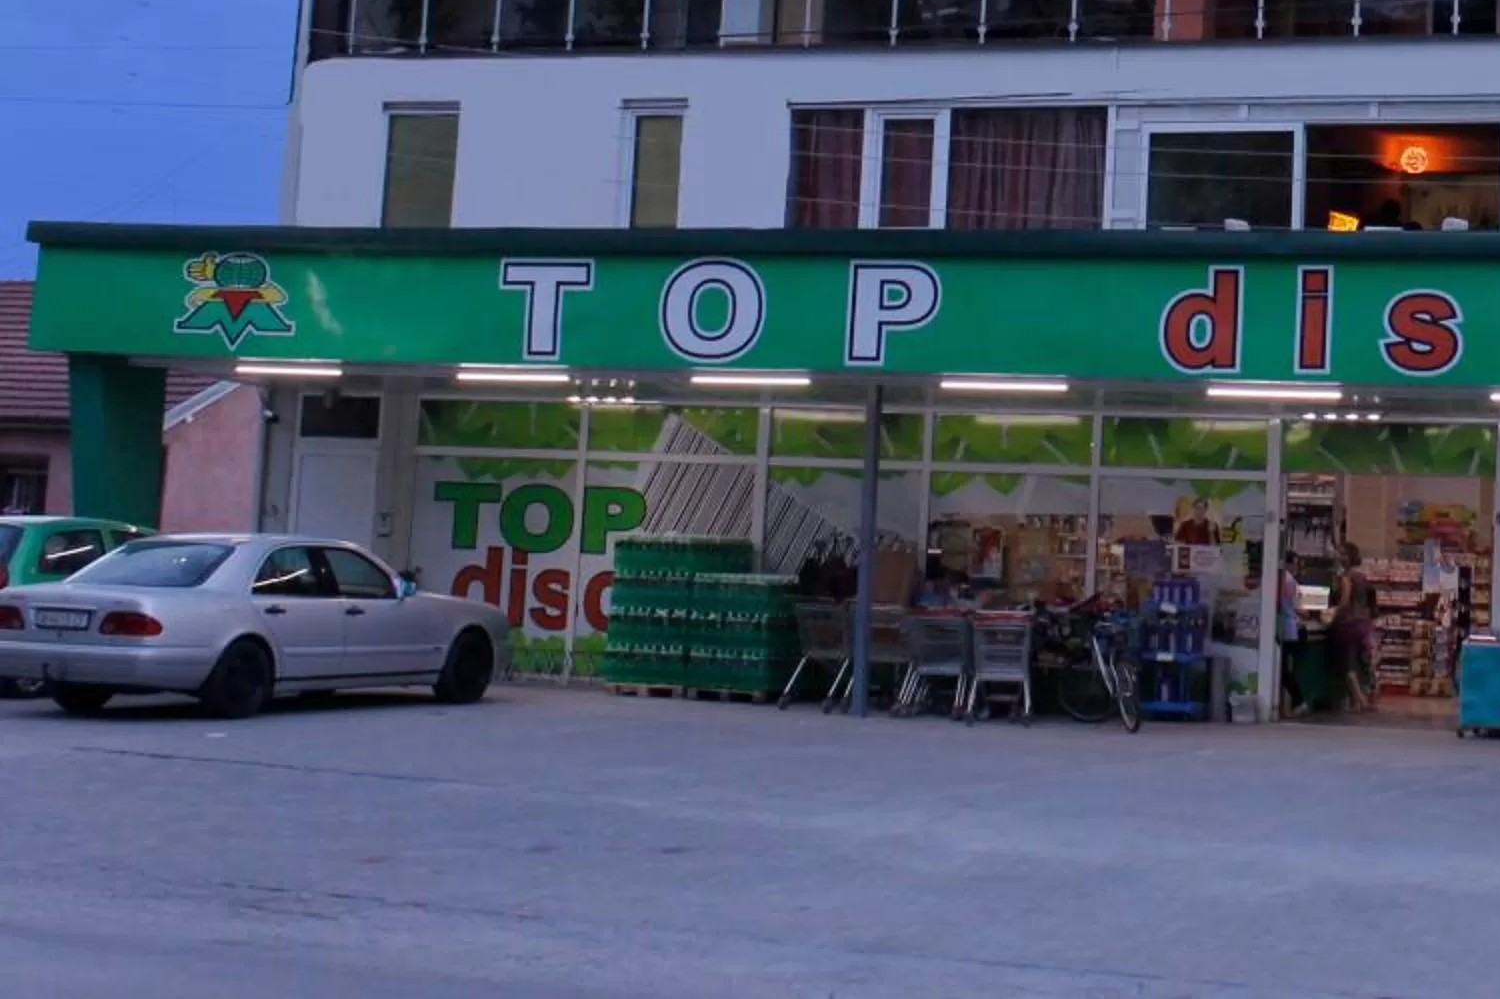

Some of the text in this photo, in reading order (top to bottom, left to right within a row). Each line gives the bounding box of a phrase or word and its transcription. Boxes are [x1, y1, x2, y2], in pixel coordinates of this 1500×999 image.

[499, 257, 943, 367] TOP
[434, 481, 647, 555] TOP
[452, 545, 615, 632] disc
